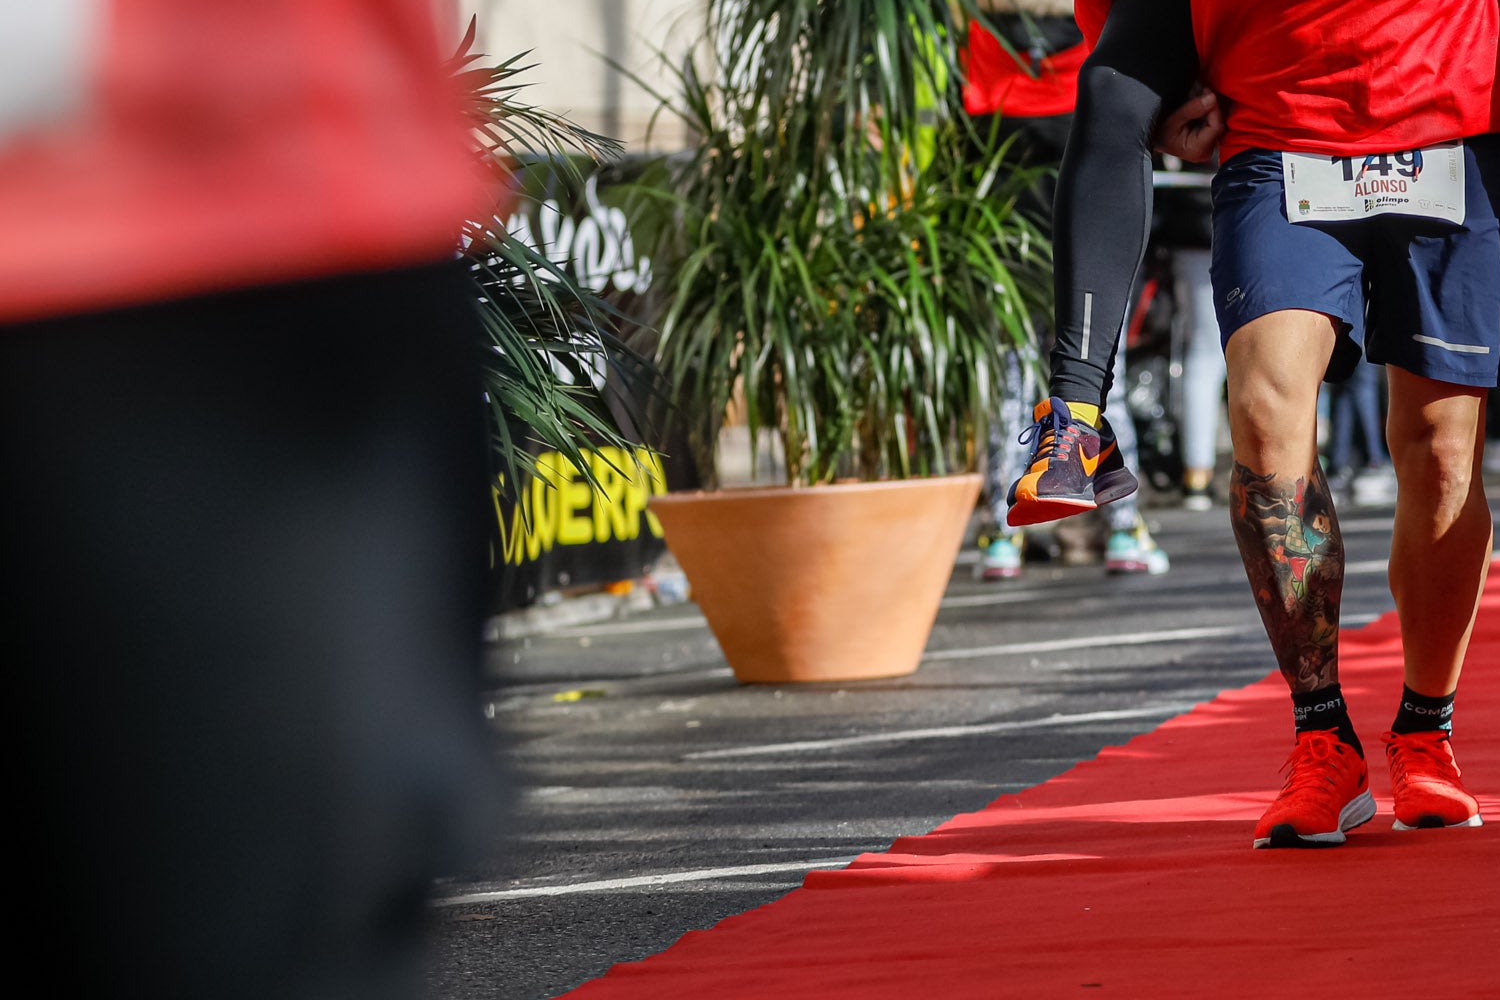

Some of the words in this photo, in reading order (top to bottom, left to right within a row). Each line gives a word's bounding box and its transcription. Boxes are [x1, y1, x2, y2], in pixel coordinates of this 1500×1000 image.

[1332, 150, 1424, 181] 149
[1354, 180, 1407, 197] ALONSO
[1376, 196, 1409, 204] olimpo
